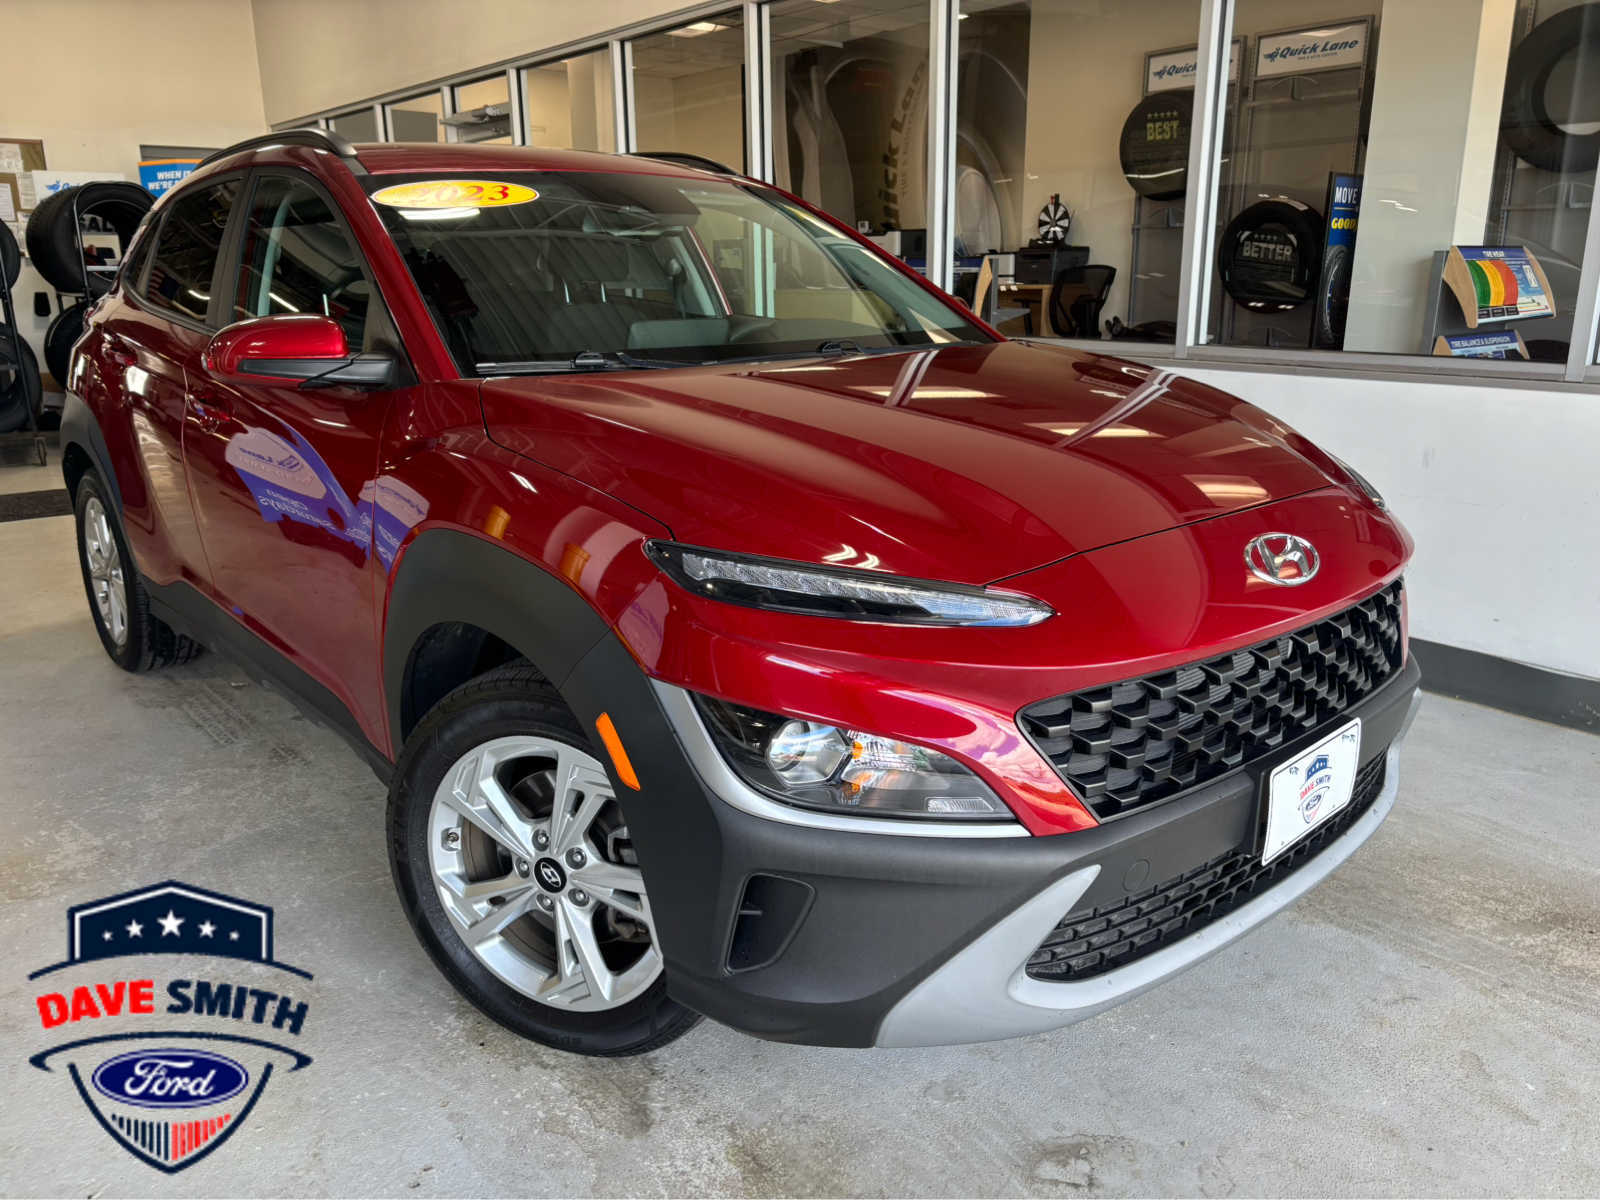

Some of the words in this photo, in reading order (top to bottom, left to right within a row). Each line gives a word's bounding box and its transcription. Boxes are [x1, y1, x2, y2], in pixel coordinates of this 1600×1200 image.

[1279, 43, 1318, 59] Quick
[1320, 39, 1360, 52] Lane
[1146, 120, 1179, 140] BEST
[157, 170, 182, 180] WHEN
[410, 184, 510, 206] 2023
[1335, 186, 1358, 204] MOVE
[1242, 241, 1293, 261] BETTER
